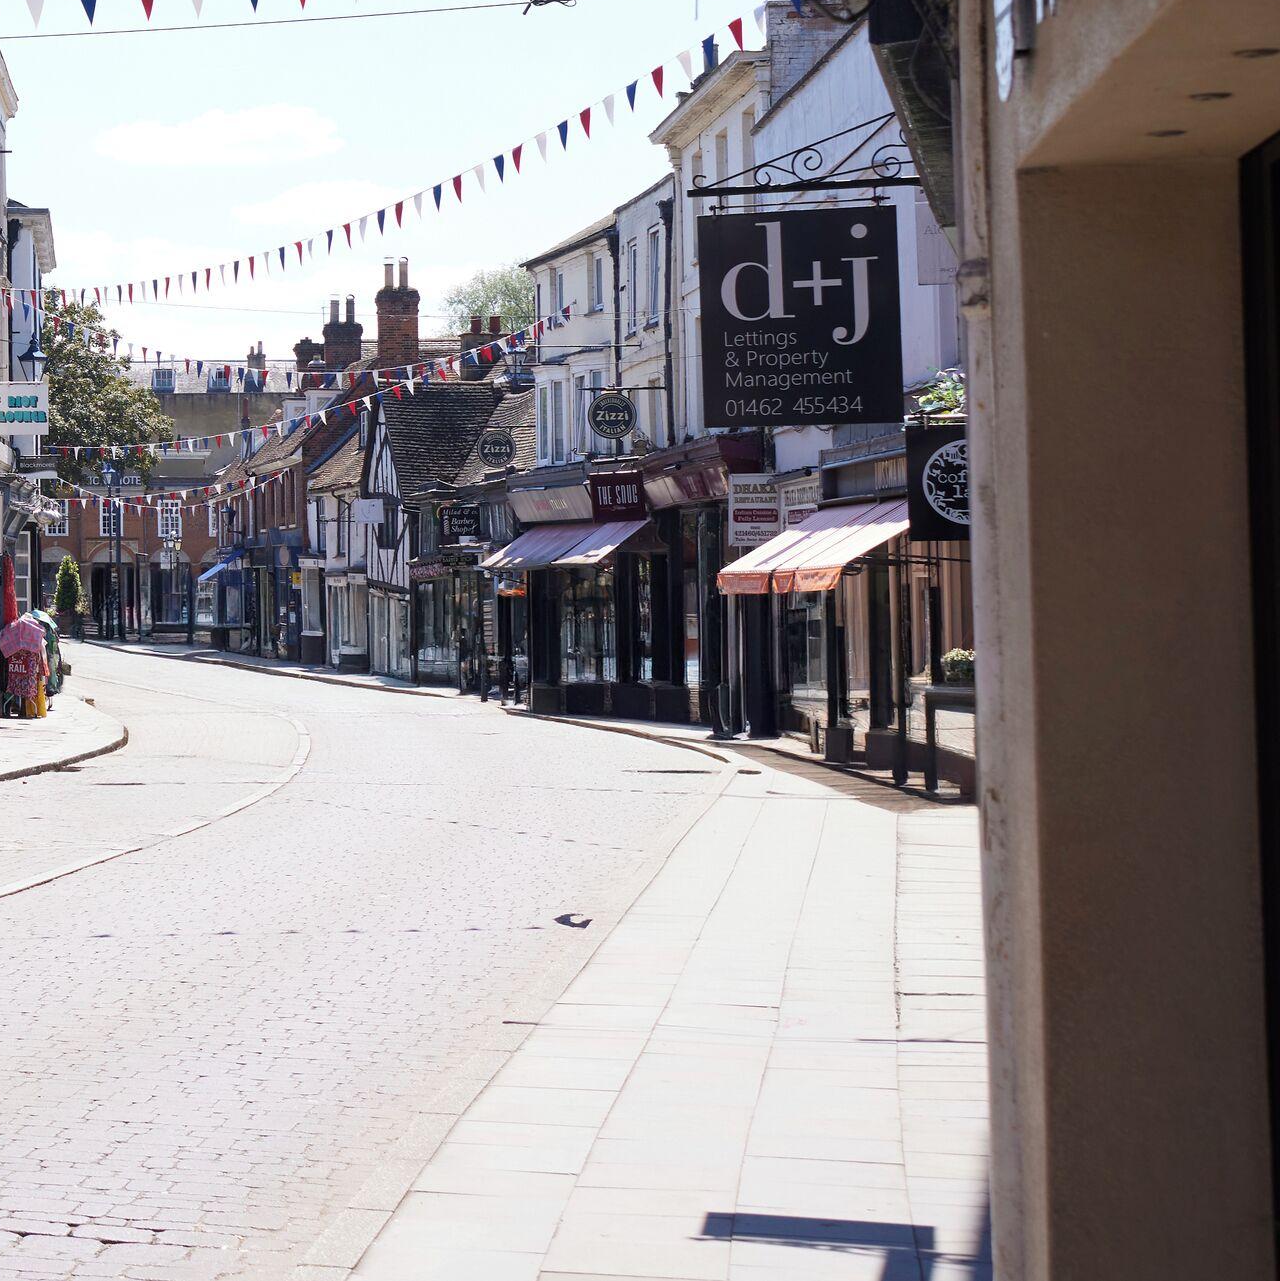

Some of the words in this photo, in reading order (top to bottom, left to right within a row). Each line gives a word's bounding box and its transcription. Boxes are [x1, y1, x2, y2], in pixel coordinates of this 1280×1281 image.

[721, 221, 879, 345] d+j
[724, 330, 797, 349] Lettings
[725, 351, 739, 367] &
[747, 350, 829, 369] Property
[725, 370, 853, 390] Management
[8, 395, 39, 409] RIOT
[725, 398, 783, 417] 01462
[793, 396, 863, 415] 455434
[596, 410, 629, 421] Zizzi
[599, 424, 626, 434] ITALIAN
[484, 444, 510, 453] Zizzi
[597, 485, 613, 505] THE
[615, 483, 638, 505] SNUG
[733, 483, 778, 494] DHAKA
[734, 496, 777, 504] RESTAURANT
[451, 517, 474, 525] Barber
[450, 525, 469, 535] Shop
[8, 663, 27, 673] RAIL
